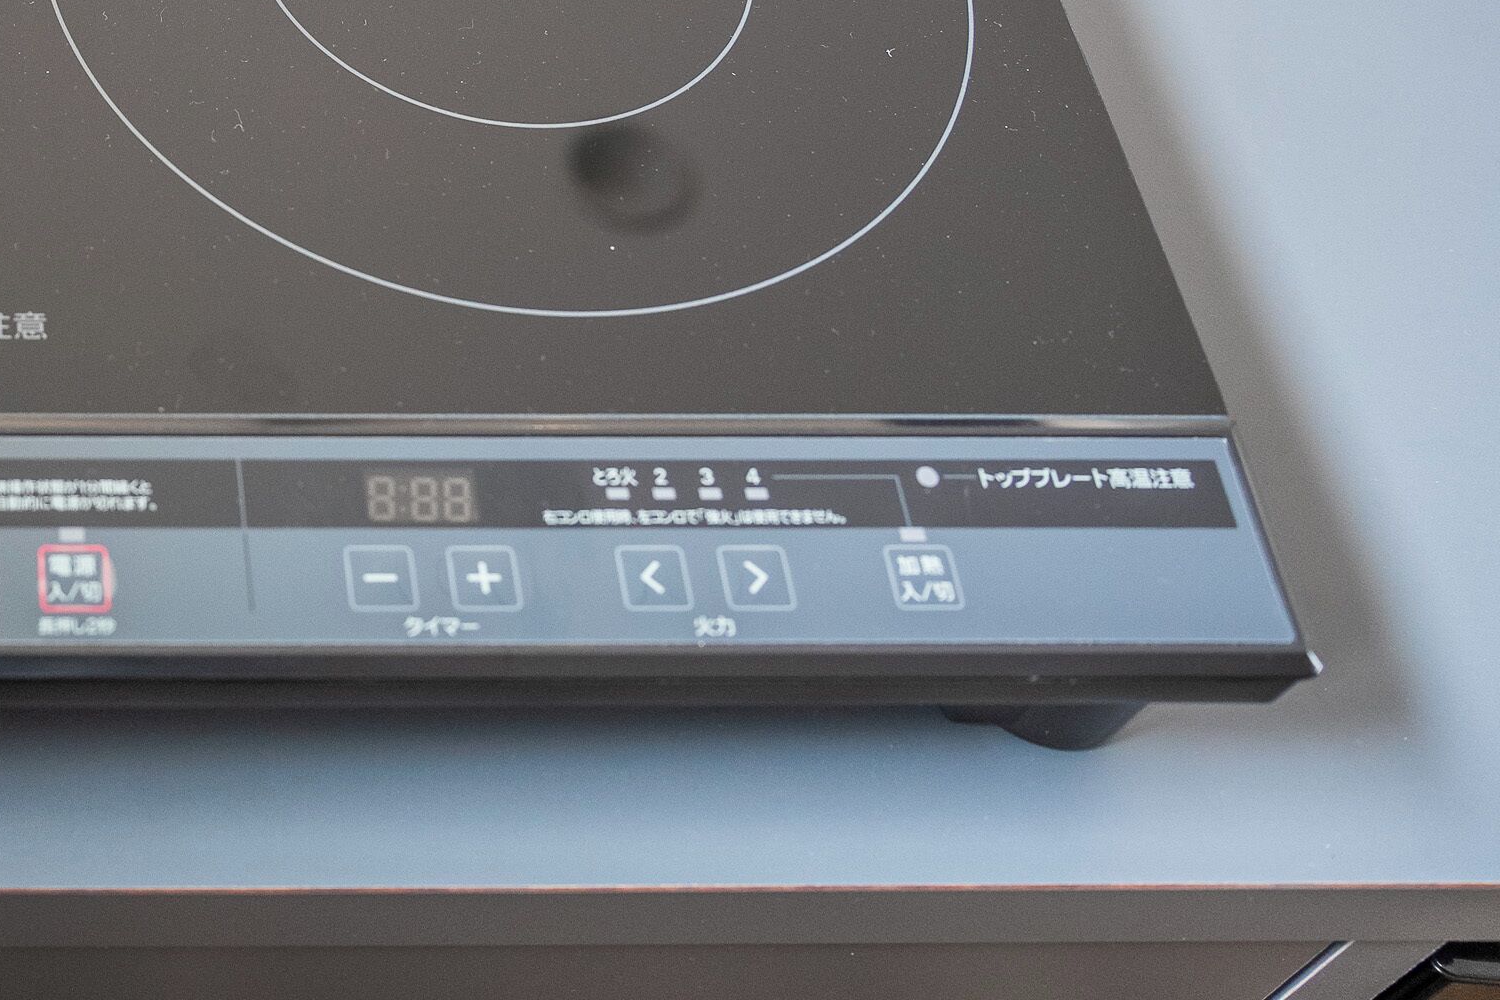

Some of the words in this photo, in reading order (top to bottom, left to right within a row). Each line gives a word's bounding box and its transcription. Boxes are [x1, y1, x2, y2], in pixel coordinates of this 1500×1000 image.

[652, 467, 668, 486] 2
[699, 467, 715, 486] 3
[745, 467, 761, 486] 4
[977, 466, 1195, 490] トッププレート高温注意
[403, 615, 481, 638] タイマー
